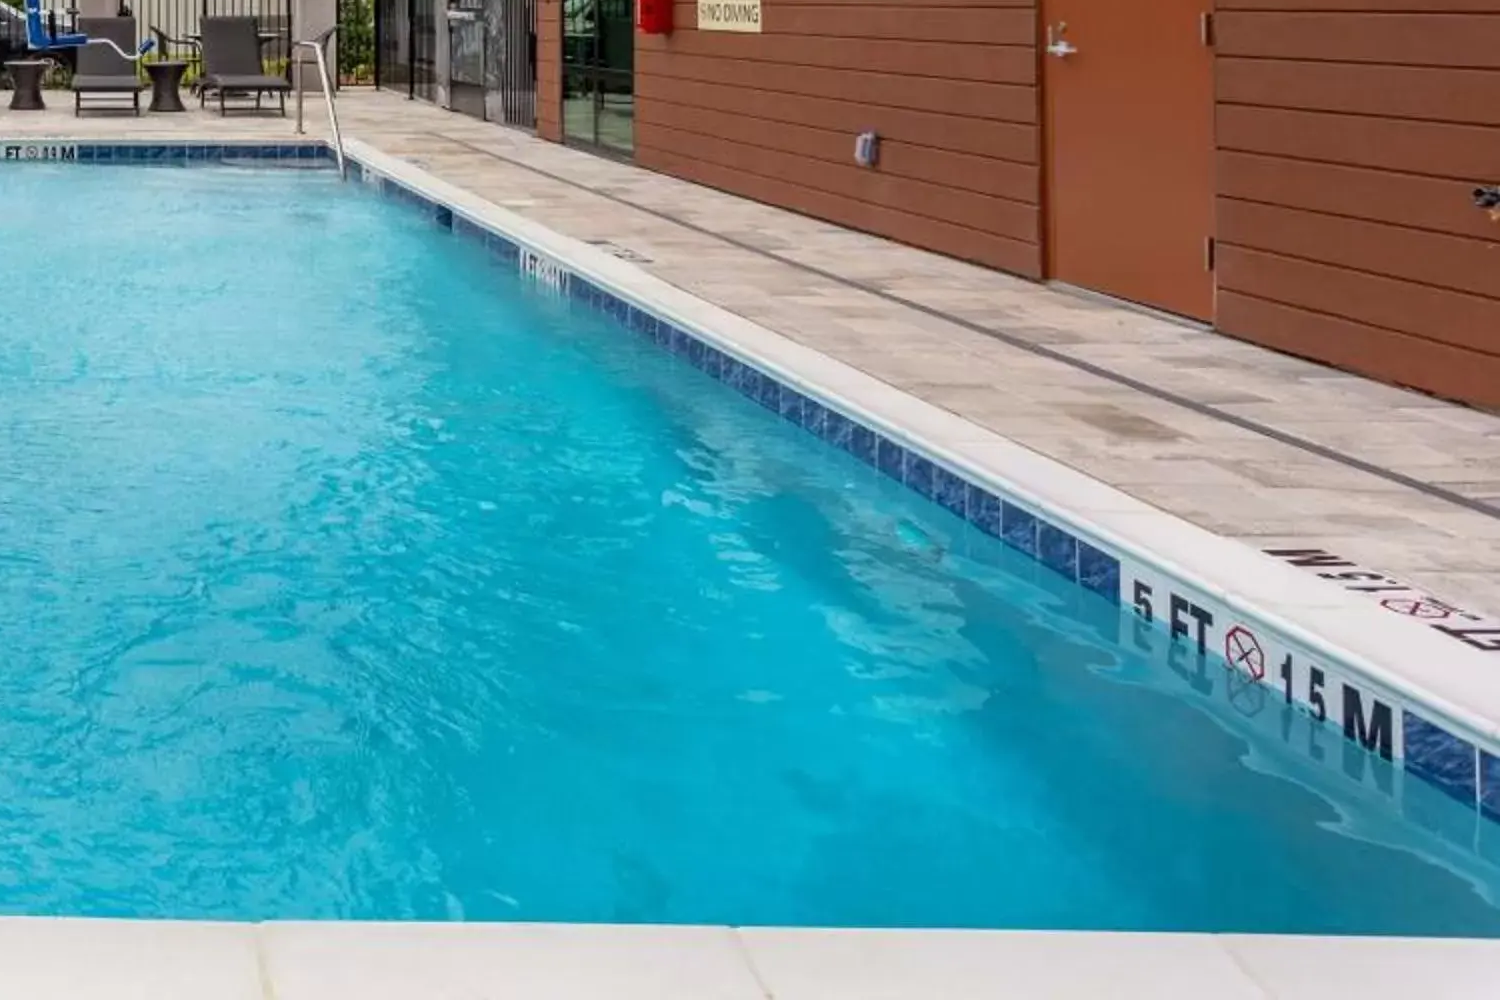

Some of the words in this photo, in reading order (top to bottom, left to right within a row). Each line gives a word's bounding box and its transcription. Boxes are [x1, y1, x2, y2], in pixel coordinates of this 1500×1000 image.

[707, 3, 722, 22] NO
[724, 3, 759, 24] DIVING
[1133, 579, 1153, 623] 5
[1170, 592, 1213, 656] FT
[1342, 682, 1394, 762] M
